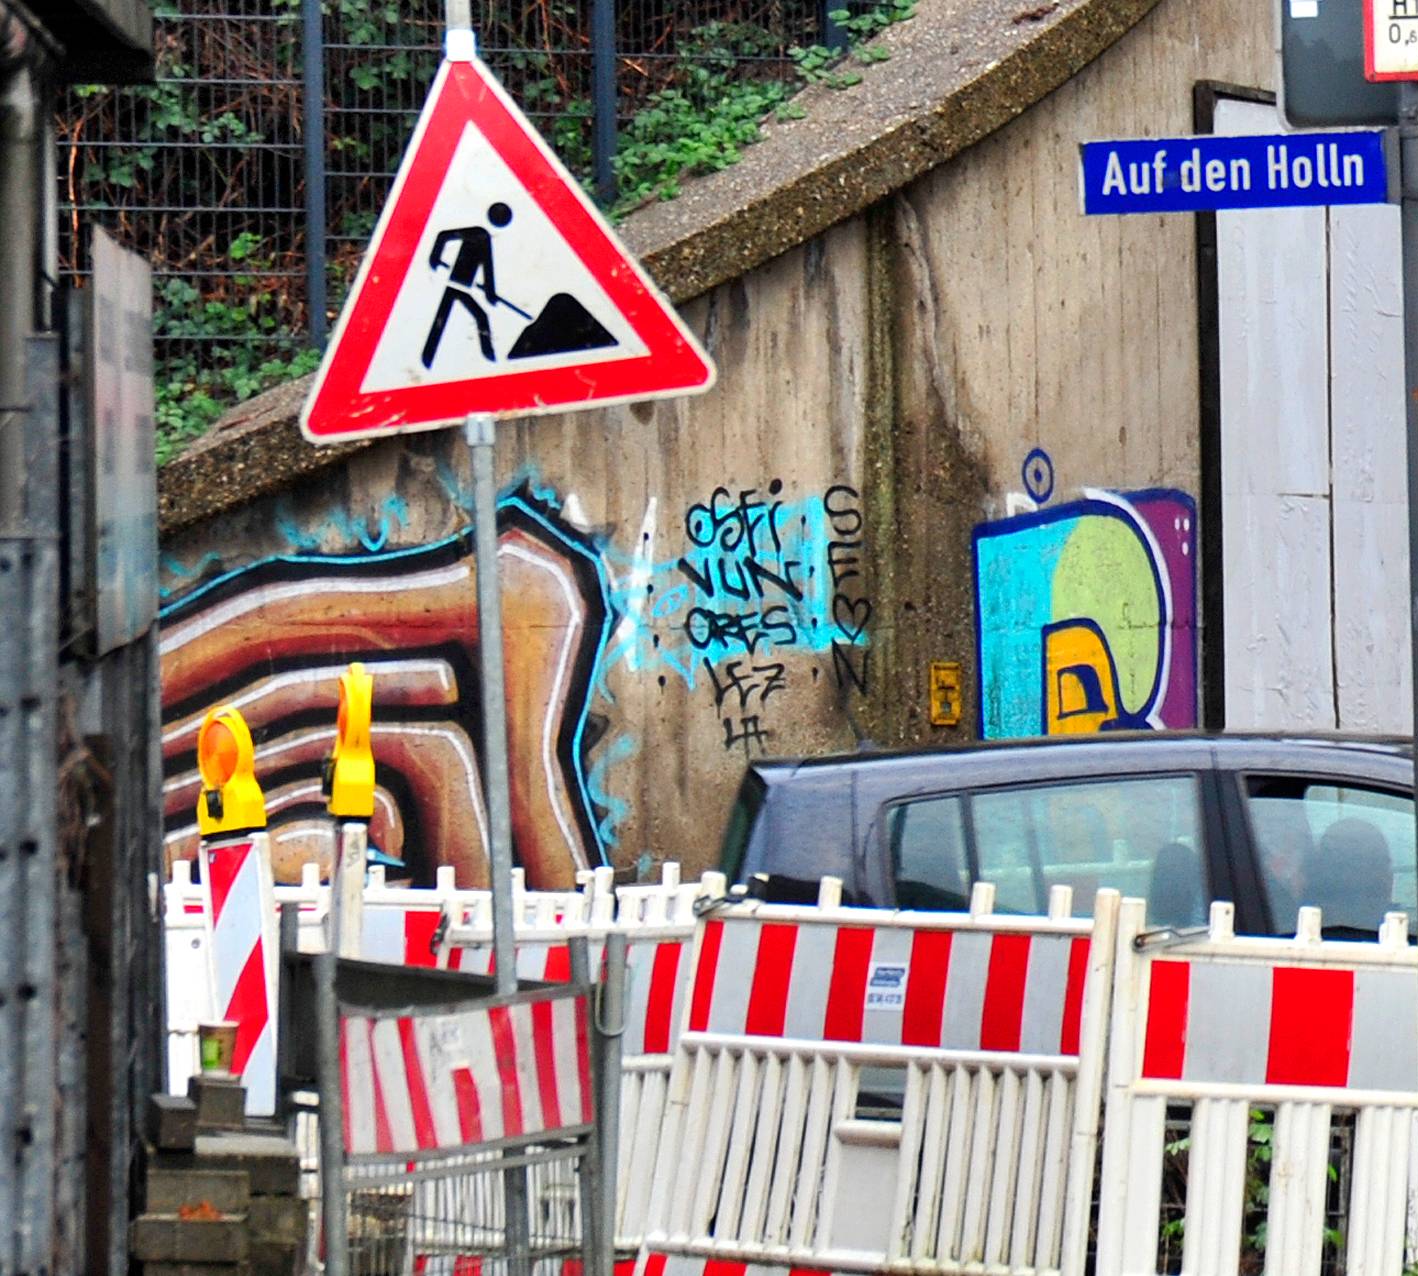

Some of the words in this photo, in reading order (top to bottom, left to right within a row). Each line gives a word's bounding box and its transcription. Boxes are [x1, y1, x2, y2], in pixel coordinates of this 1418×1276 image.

[1102, 150, 1168, 196] Auf
[1180, 148, 1251, 193] den
[1266, 143, 1365, 190] Holln
